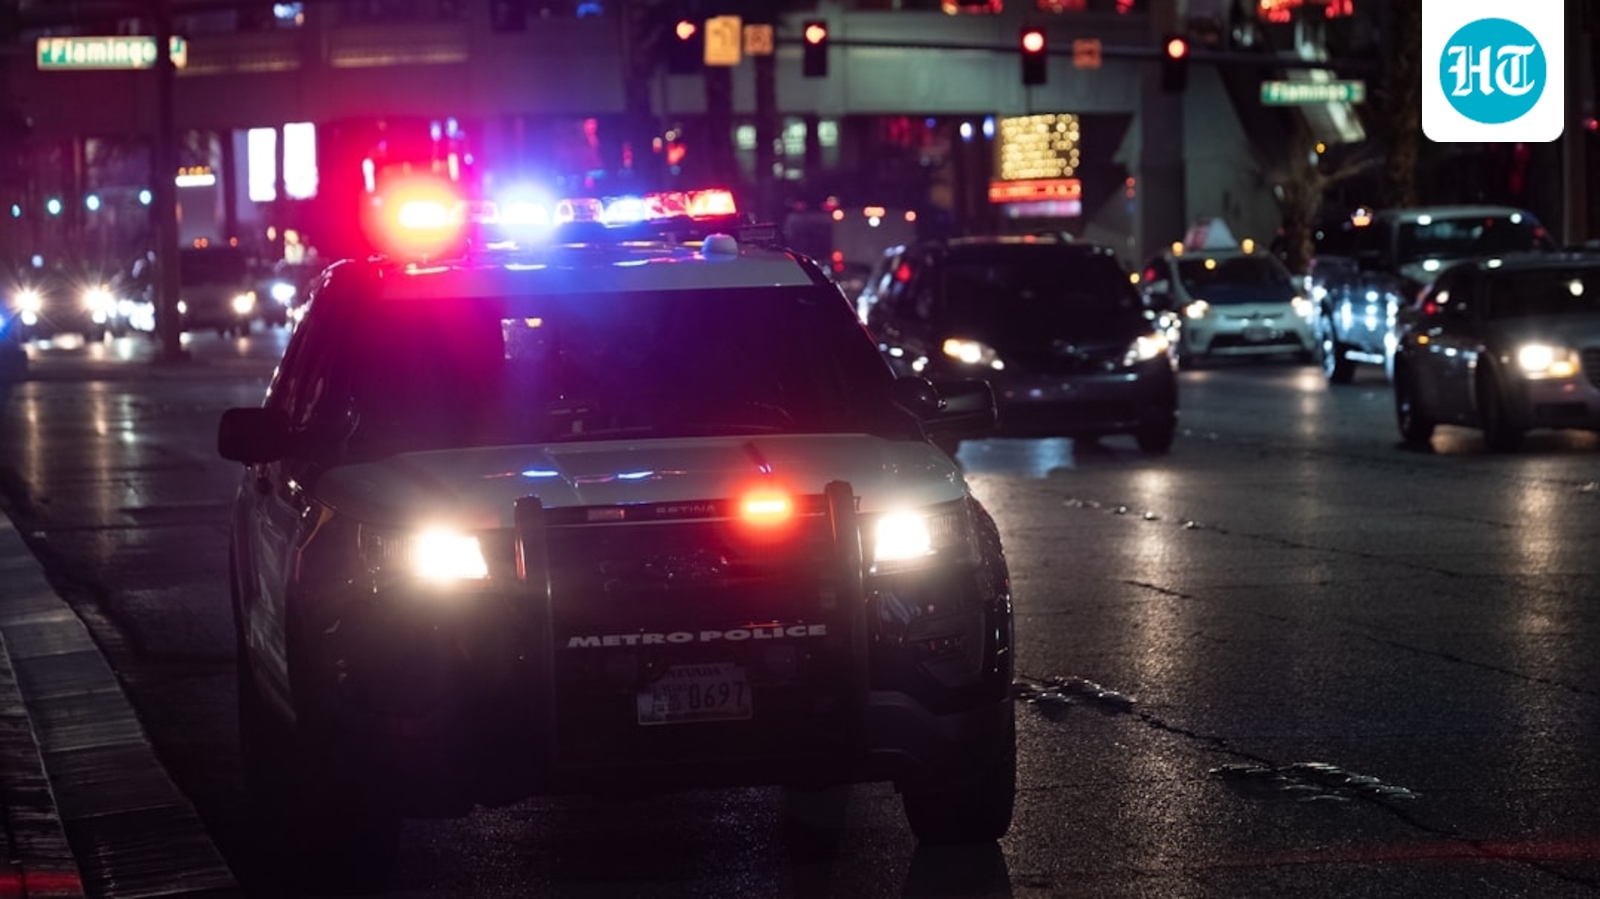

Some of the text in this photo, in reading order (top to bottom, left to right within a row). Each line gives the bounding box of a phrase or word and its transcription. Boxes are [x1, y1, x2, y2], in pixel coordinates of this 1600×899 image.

[50, 39, 157, 67] Flamingo
[1269, 83, 1348, 102] Flamingo
[567, 623, 827, 648] METRO POLICE
[688, 681, 745, 709] 0697
